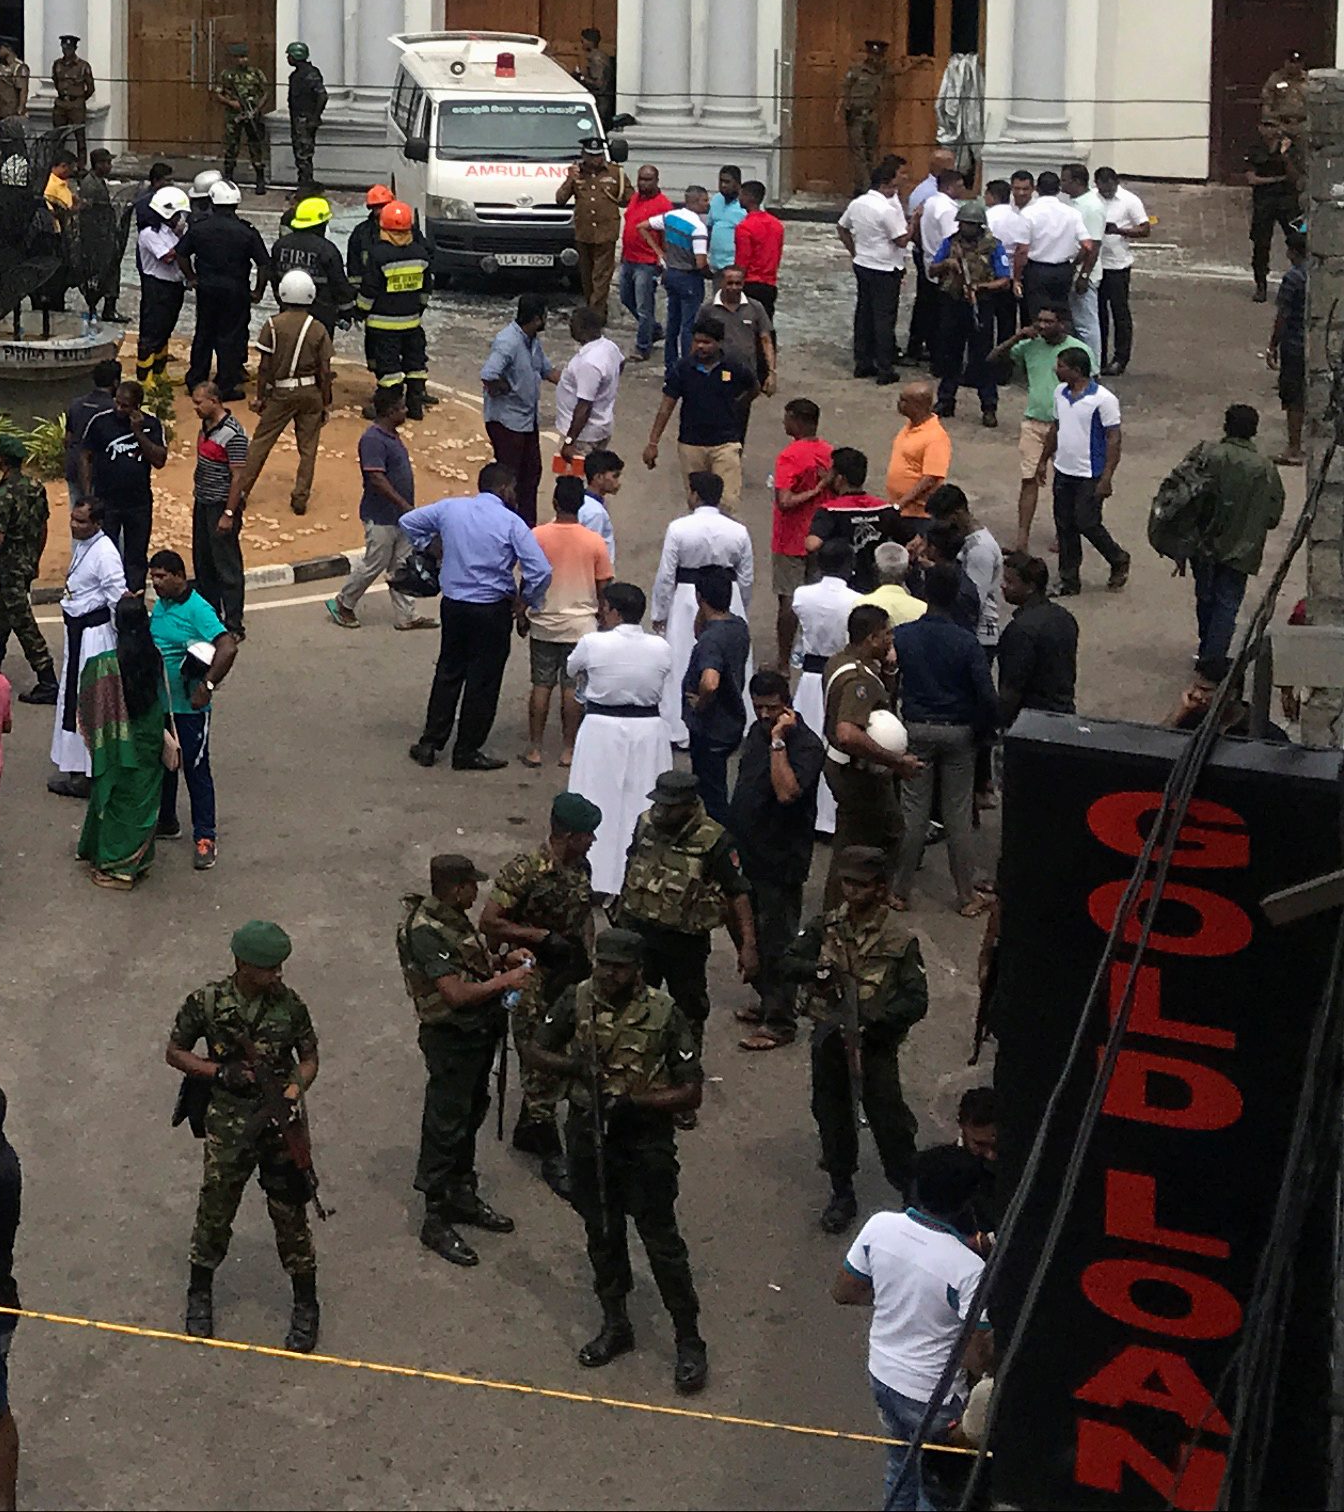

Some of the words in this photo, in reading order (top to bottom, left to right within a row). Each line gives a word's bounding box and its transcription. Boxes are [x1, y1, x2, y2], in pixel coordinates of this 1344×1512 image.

[279, 247, 318, 266] FIRE
[1085, 788, 1254, 1133] GOLD
[1073, 1167, 1246, 1512] LOAN
